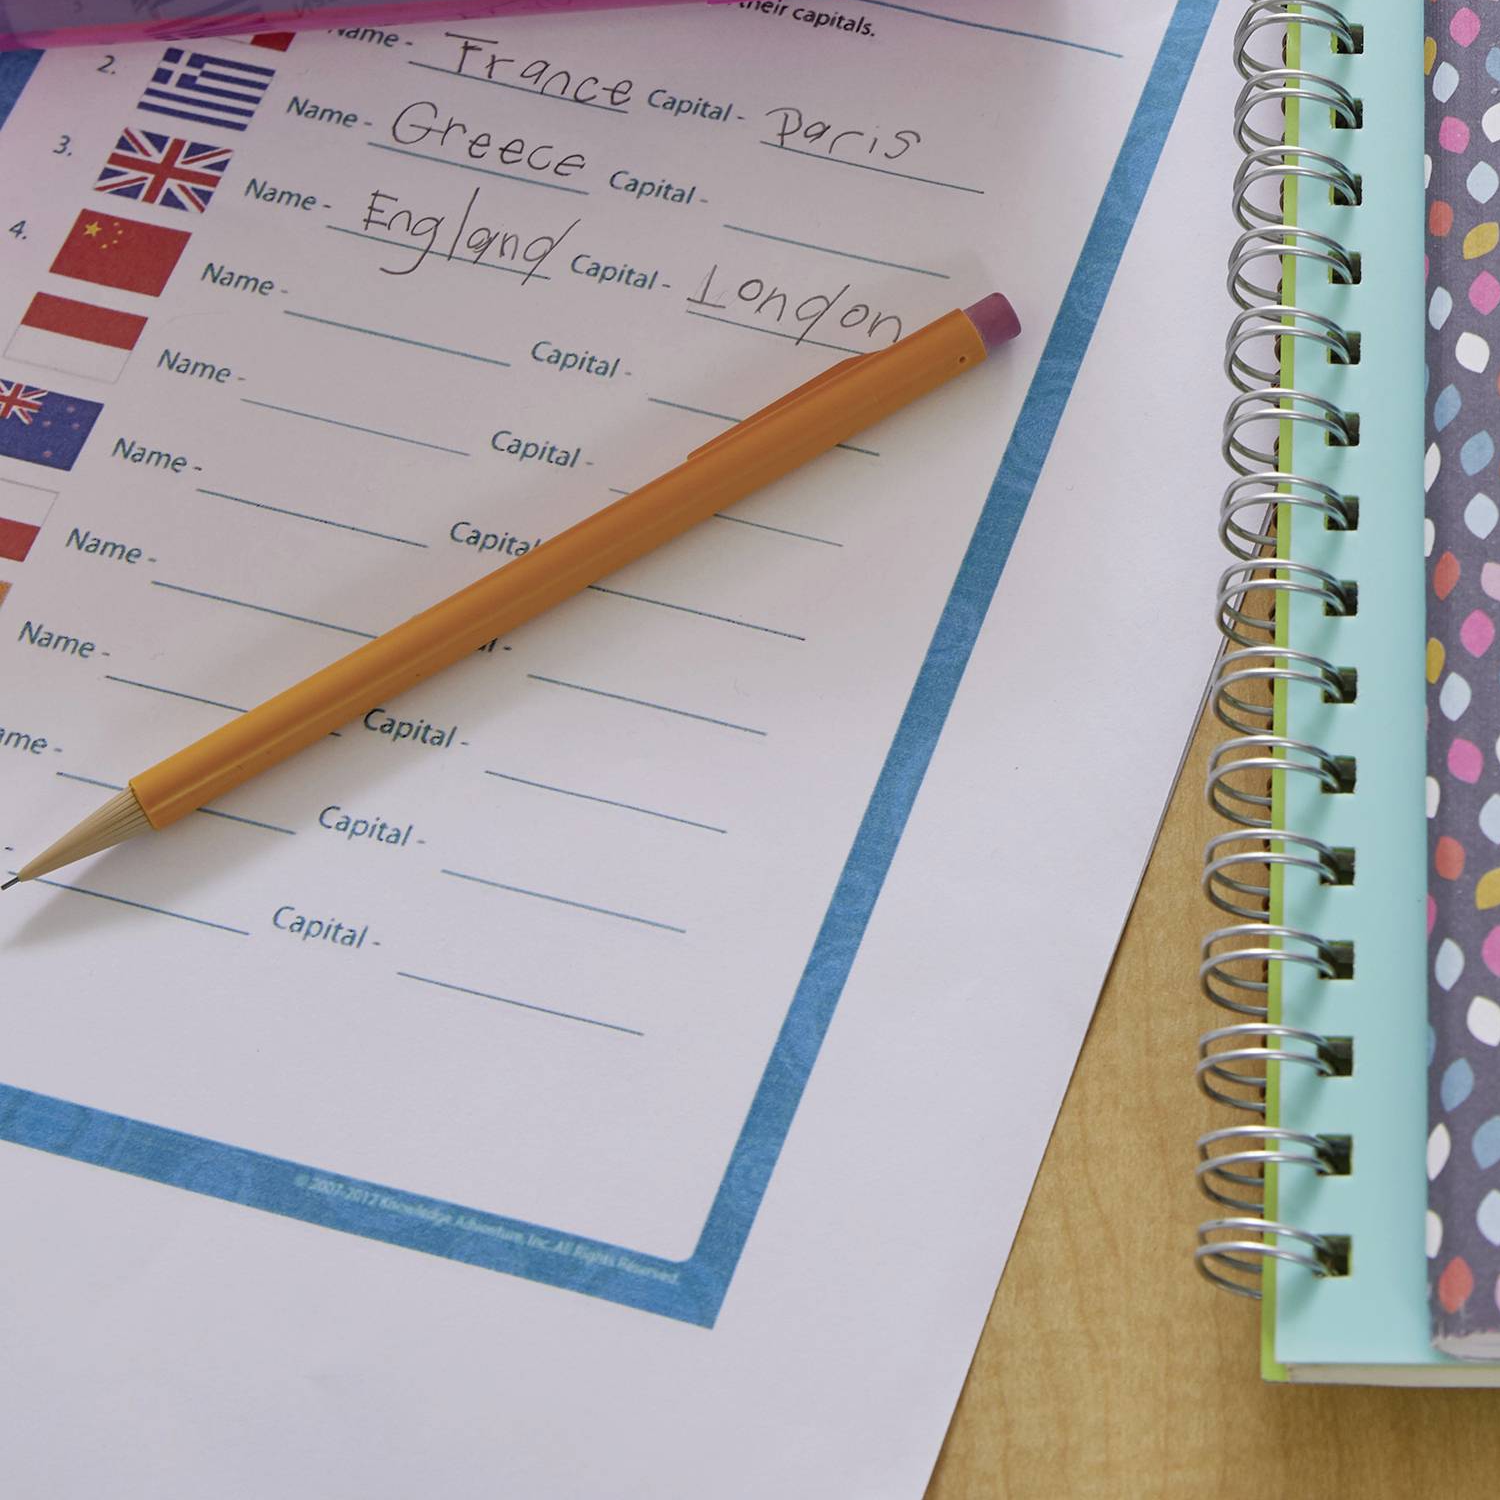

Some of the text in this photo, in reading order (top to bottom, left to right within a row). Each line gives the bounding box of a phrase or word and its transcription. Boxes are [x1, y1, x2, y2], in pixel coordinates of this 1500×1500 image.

[327, 26, 400, 48] ame
[792, 8, 876, 38] capitals.
[96, 54, 117, 76] 2.
[444, 31, 635, 107] France
[287, 95, 358, 127] Name
[646, 87, 733, 123] Capital
[53, 134, 73, 158] 3.
[391, 100, 587, 178] Greece
[766, 107, 922, 160] Paris
[244, 178, 317, 212] Name
[608, 169, 697, 206] Capital
[8, 220, 28, 241] 4.
[362, 186, 581, 286] England
[201, 262, 275, 297] Name
[569, 253, 657, 292] Capital
[685, 264, 904, 347] London
[157, 348, 232, 384] Name
[530, 340, 620, 379] Capital
[111, 437, 188, 474] Name
[490, 430, 581, 469] Capital
[65, 527, 142, 566] Name
[18, 619, 96, 659] Name
[362, 707, 456, 748] Capital
[318, 804, 412, 847] Capital
[272, 905, 366, 950] Capital
